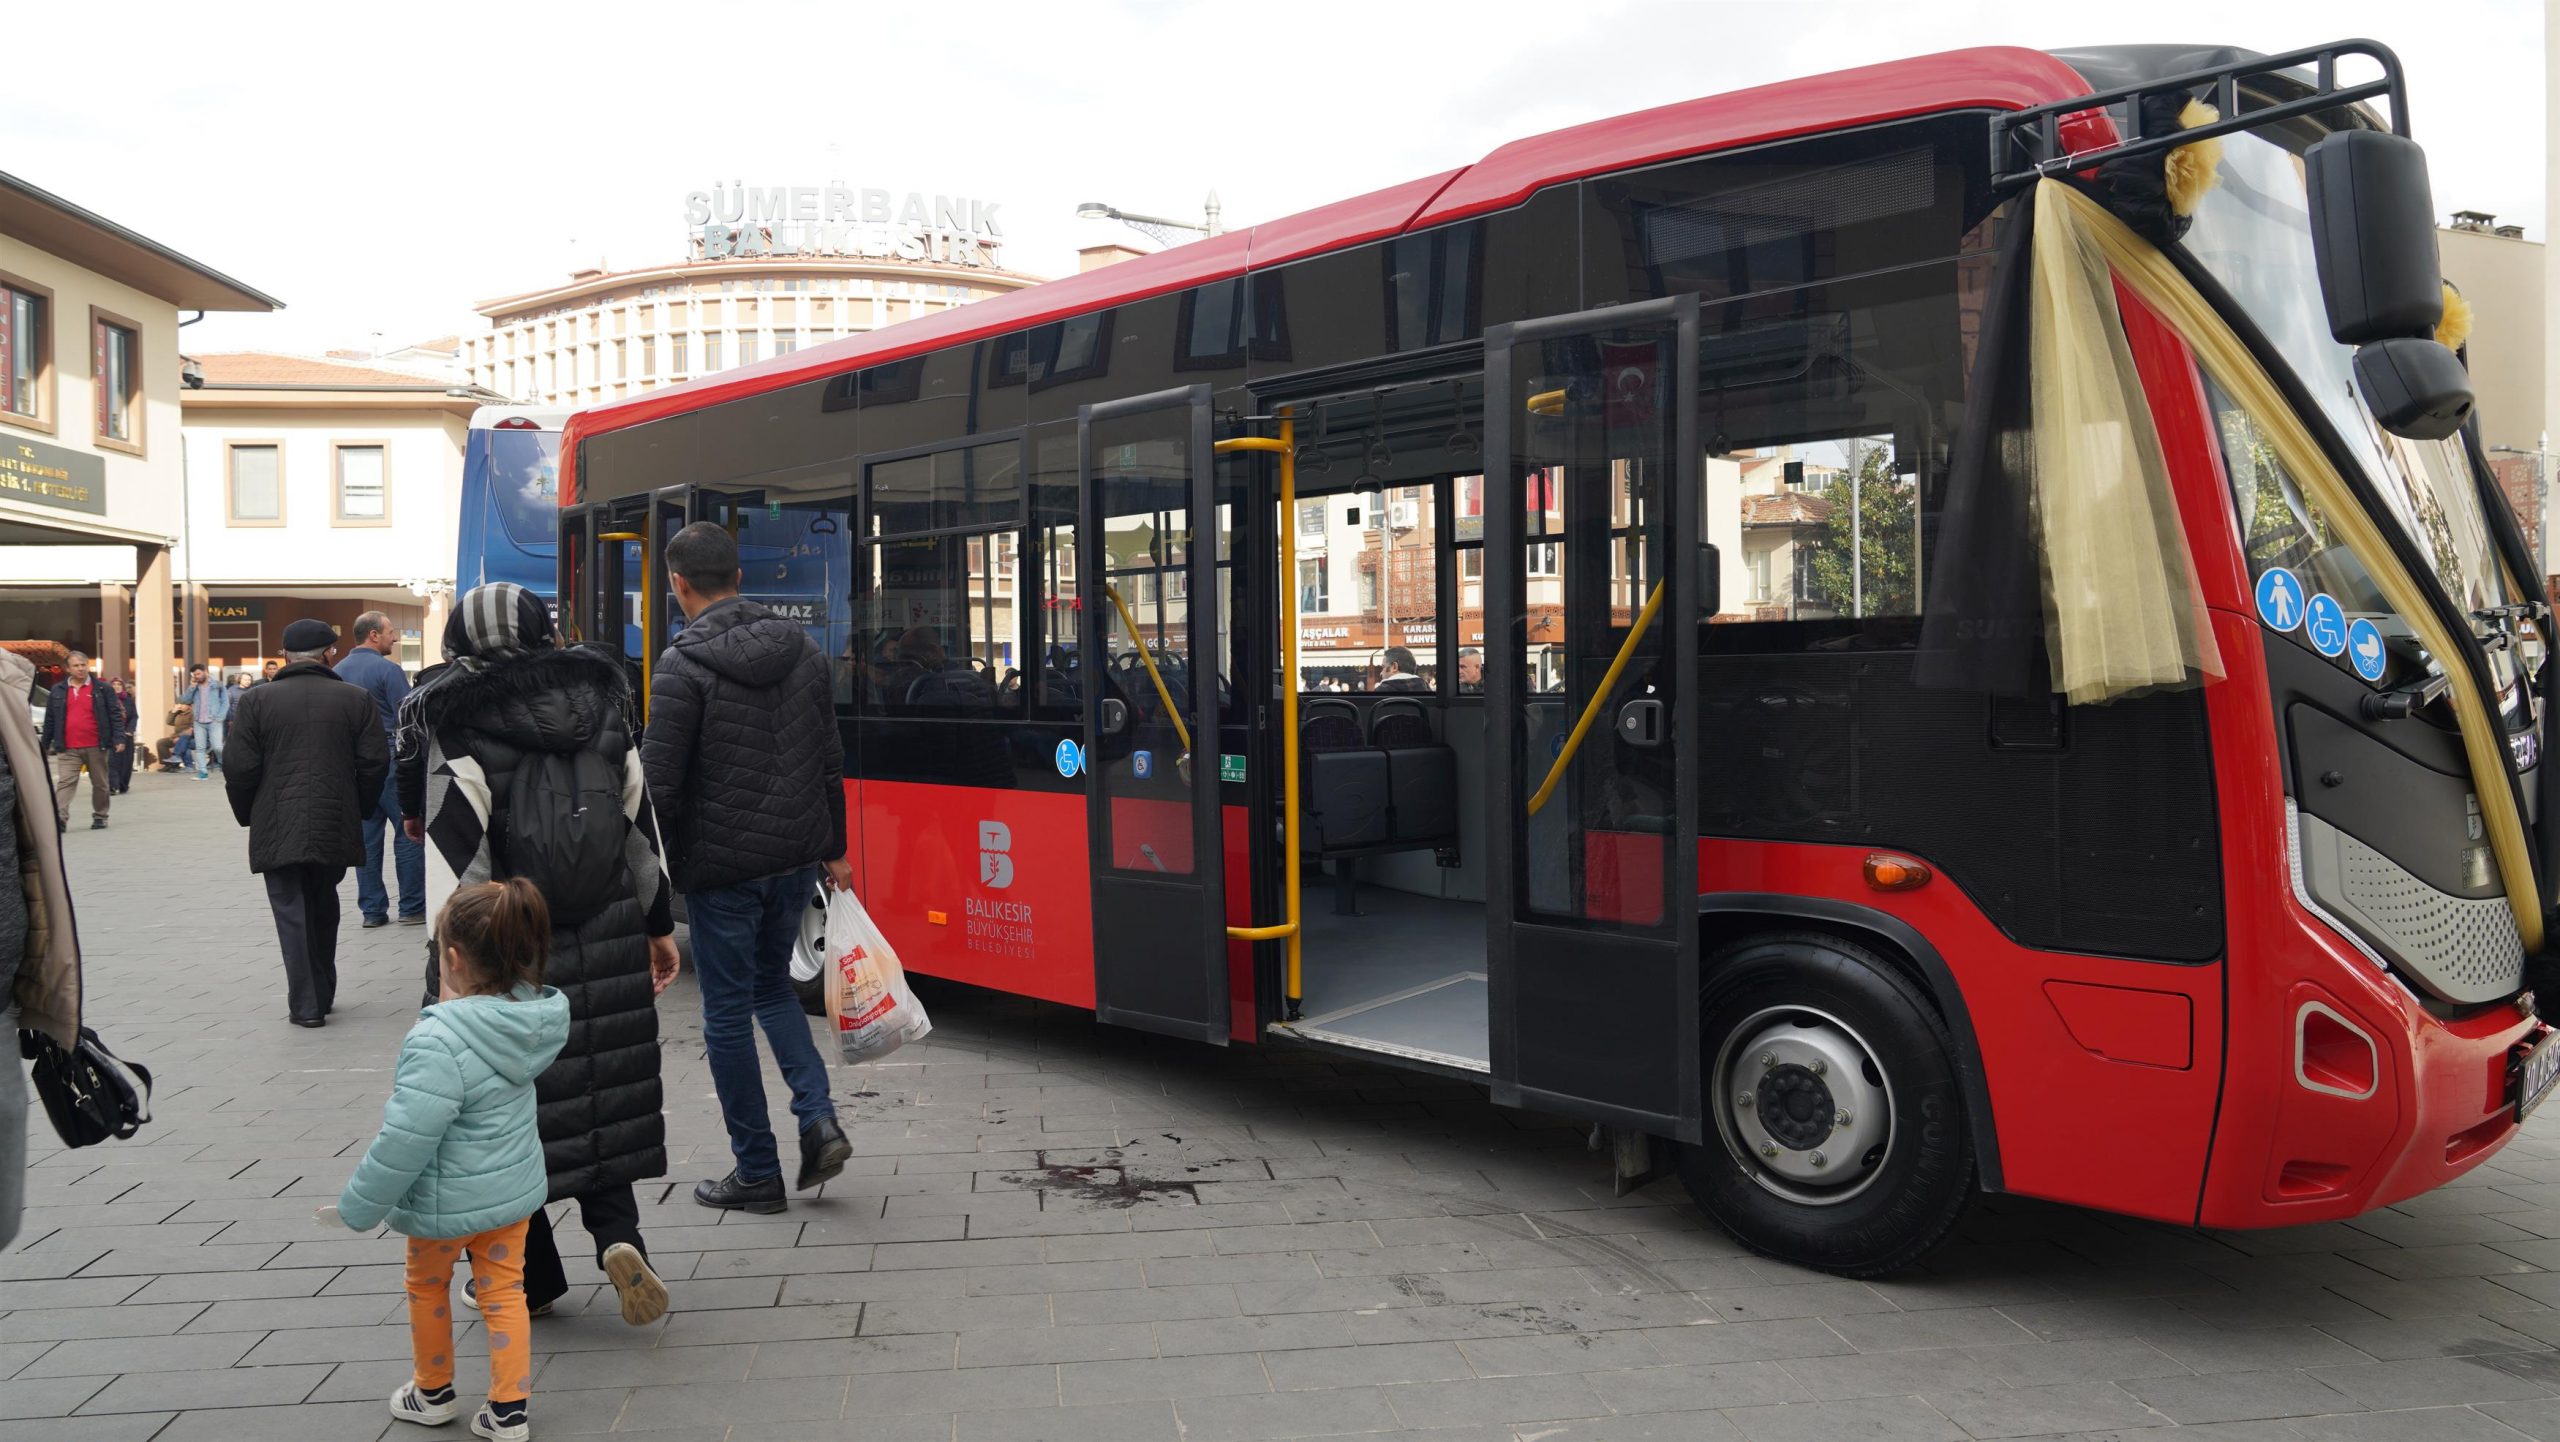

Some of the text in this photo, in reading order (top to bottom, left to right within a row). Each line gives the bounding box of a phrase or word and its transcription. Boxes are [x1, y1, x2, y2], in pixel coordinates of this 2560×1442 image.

[683, 179, 1004, 236] SÜMERBANK
[208, 607, 247, 616] NKASI
[771, 604, 812, 618] MAZ
[1147, 638, 1170, 648] GOD
[966, 897, 1033, 924] BALIKESİR
[967, 919, 1034, 944] BÜYÜKŞEHİR
[968, 939, 1035, 960] BELEDİYESİ
